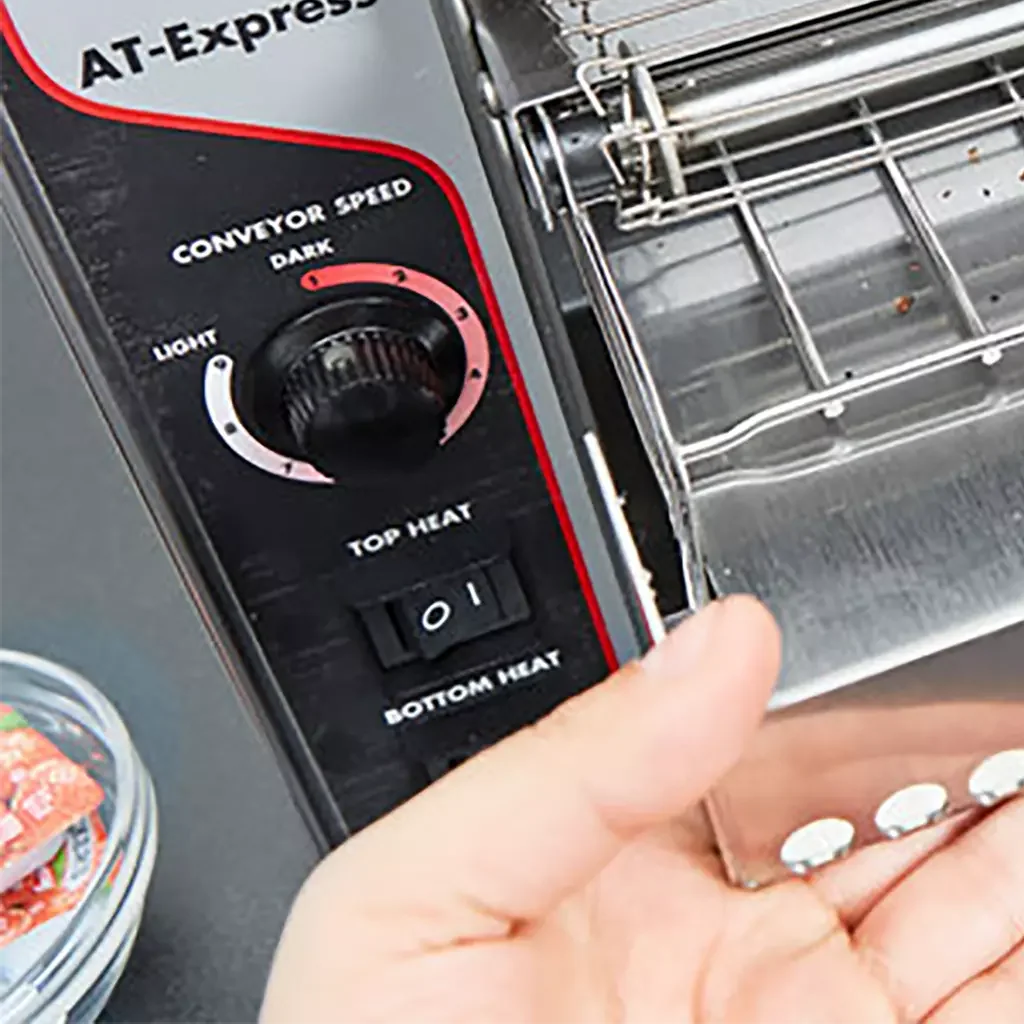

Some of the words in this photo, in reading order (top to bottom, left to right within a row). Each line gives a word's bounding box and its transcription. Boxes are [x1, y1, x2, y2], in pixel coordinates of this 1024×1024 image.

[171, 203, 327, 265] CONVEYOR
[334, 177, 413, 216] SPEED
[269, 238, 336, 270] DARK
[152, 328, 218, 362] LIGHT
[347, 528, 400, 557] TOP
[406, 502, 473, 538] HEAT
[384, 676, 493, 726] BOTTOM
[497, 650, 561, 685] HEAT
